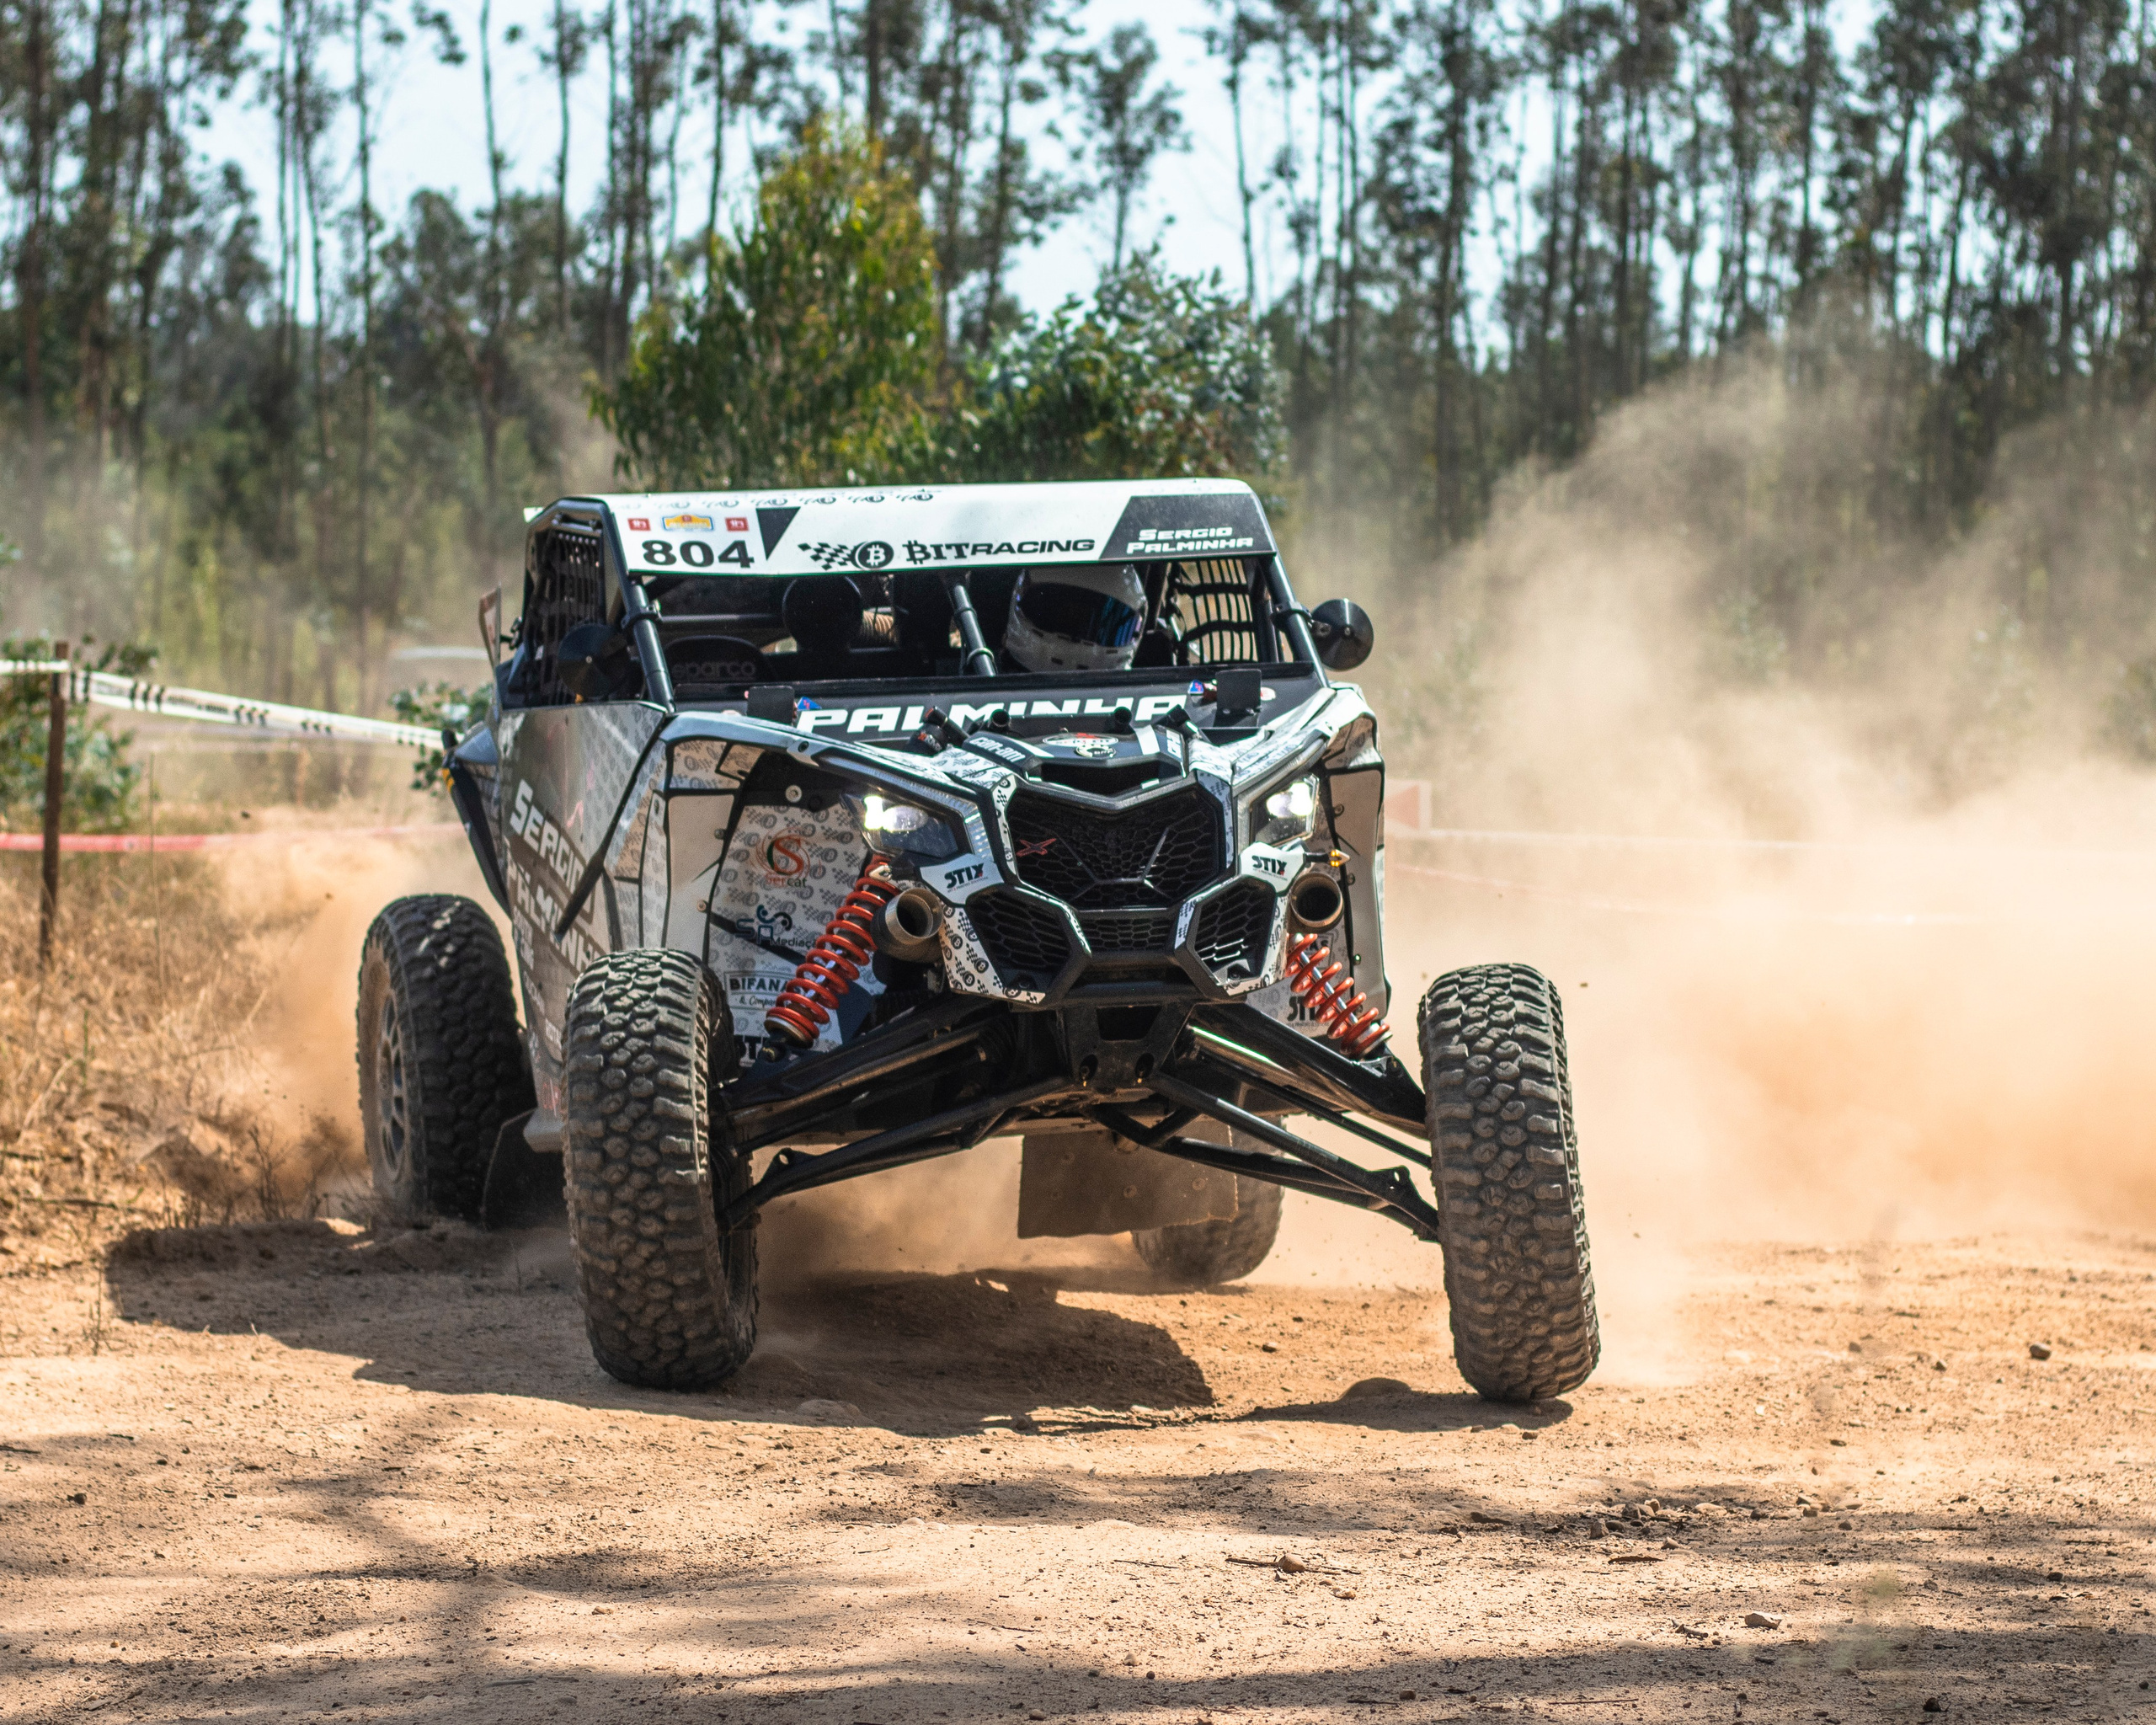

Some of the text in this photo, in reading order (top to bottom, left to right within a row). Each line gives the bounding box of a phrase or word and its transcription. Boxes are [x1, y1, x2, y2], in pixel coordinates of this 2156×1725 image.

[642, 540, 755, 569] 804
[1126, 537, 1254, 554] PALMINHA
[969, 736, 1026, 763] can-am
[944, 862, 985, 889] STIX
[1251, 855, 1288, 877] STIX
